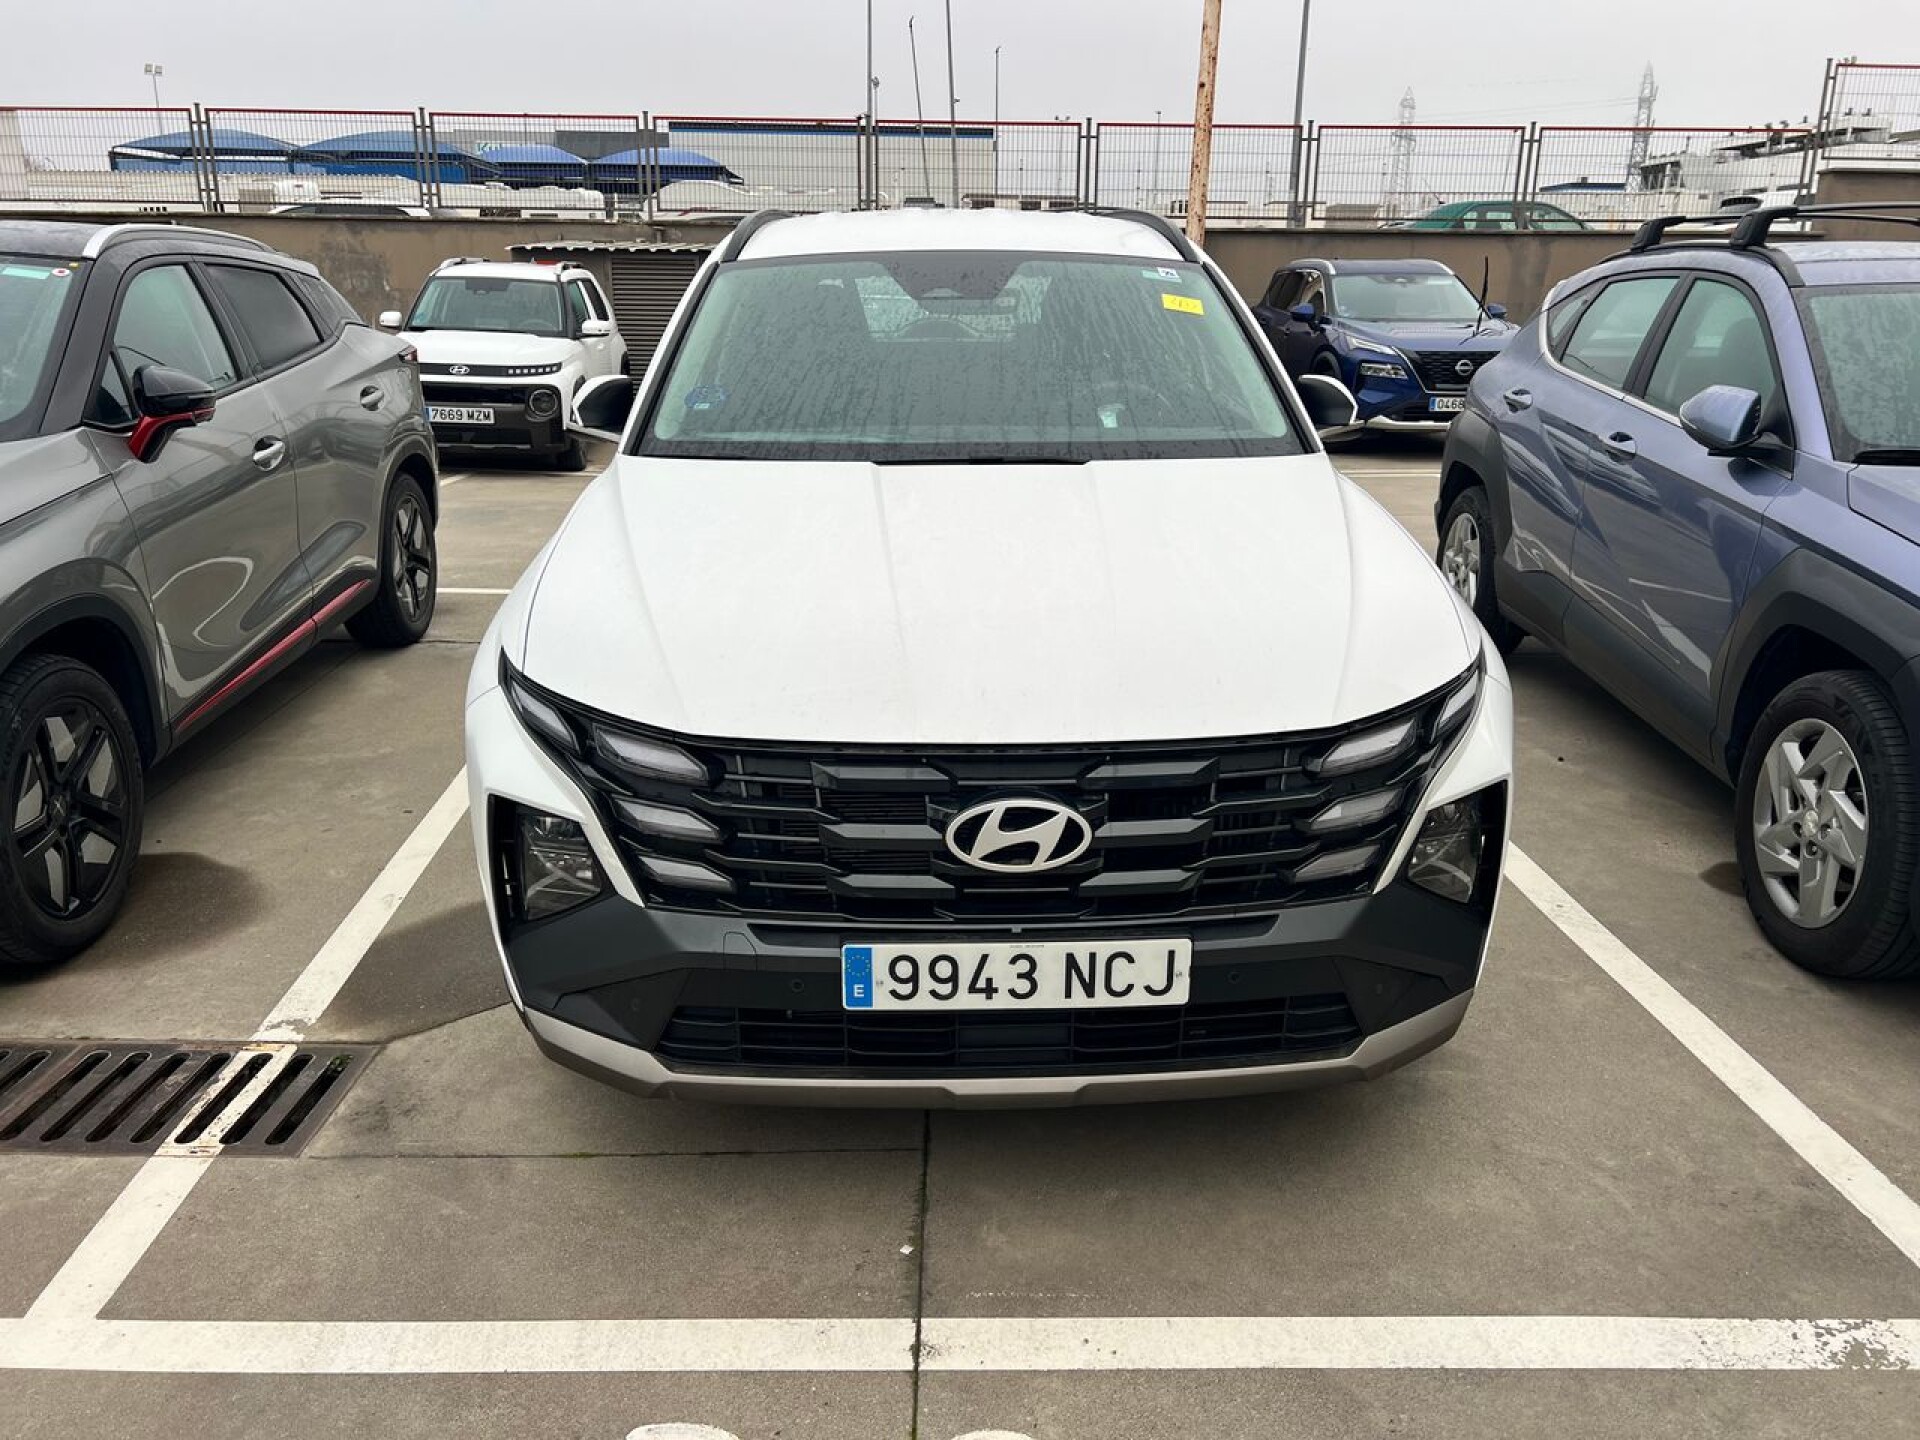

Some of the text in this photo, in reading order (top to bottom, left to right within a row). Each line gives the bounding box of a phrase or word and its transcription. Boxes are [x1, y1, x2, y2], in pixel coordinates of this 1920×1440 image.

[1438, 399, 1464, 410] 0468
[431, 408, 492, 422] 7669 MZM
[853, 950, 1176, 1001] E 9943 NCJ
